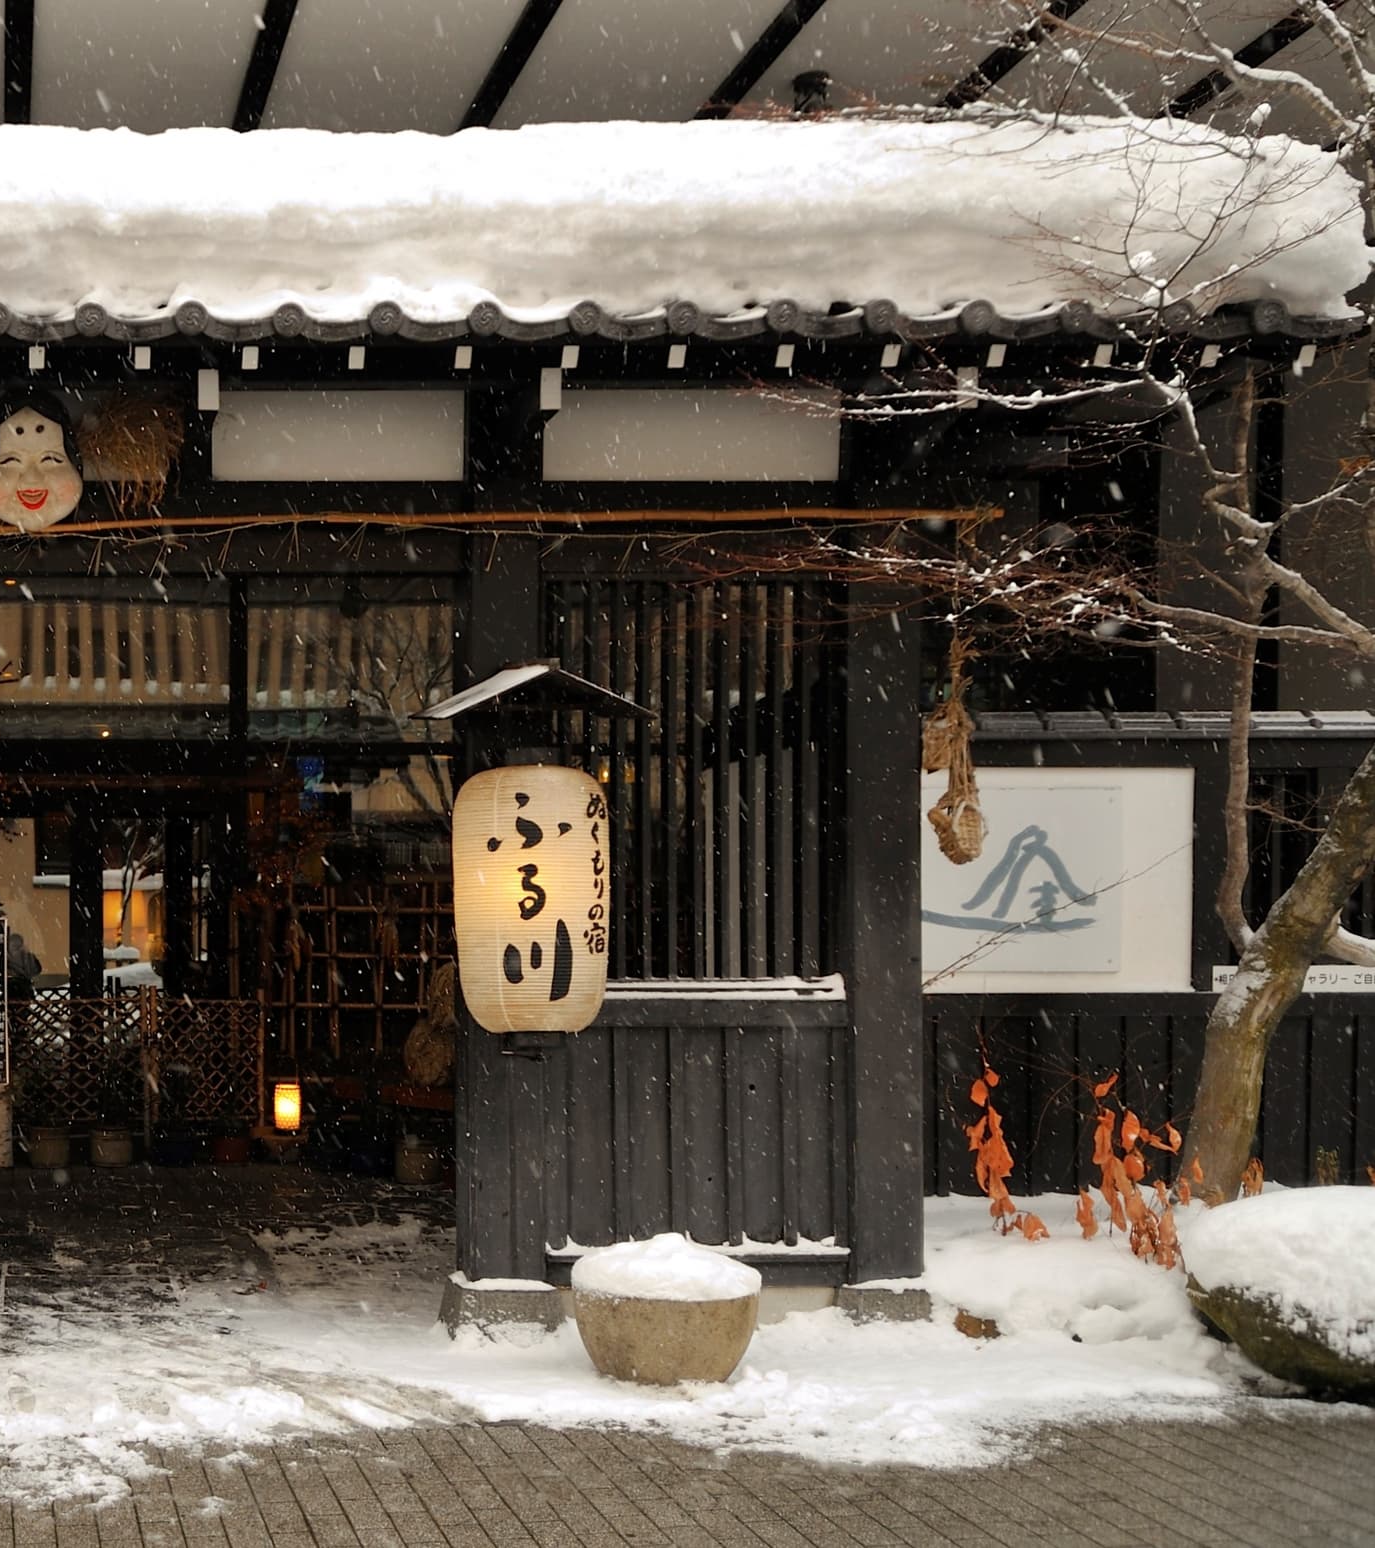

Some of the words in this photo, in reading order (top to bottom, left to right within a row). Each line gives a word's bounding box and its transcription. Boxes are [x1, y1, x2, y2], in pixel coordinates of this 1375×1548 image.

[486, 792, 573, 1002] ふる川
[583, 792, 607, 956] ぬくもりの宿
[1308, 973, 1349, 985] ャラリー
[1354, 973, 1375, 985] ご自
